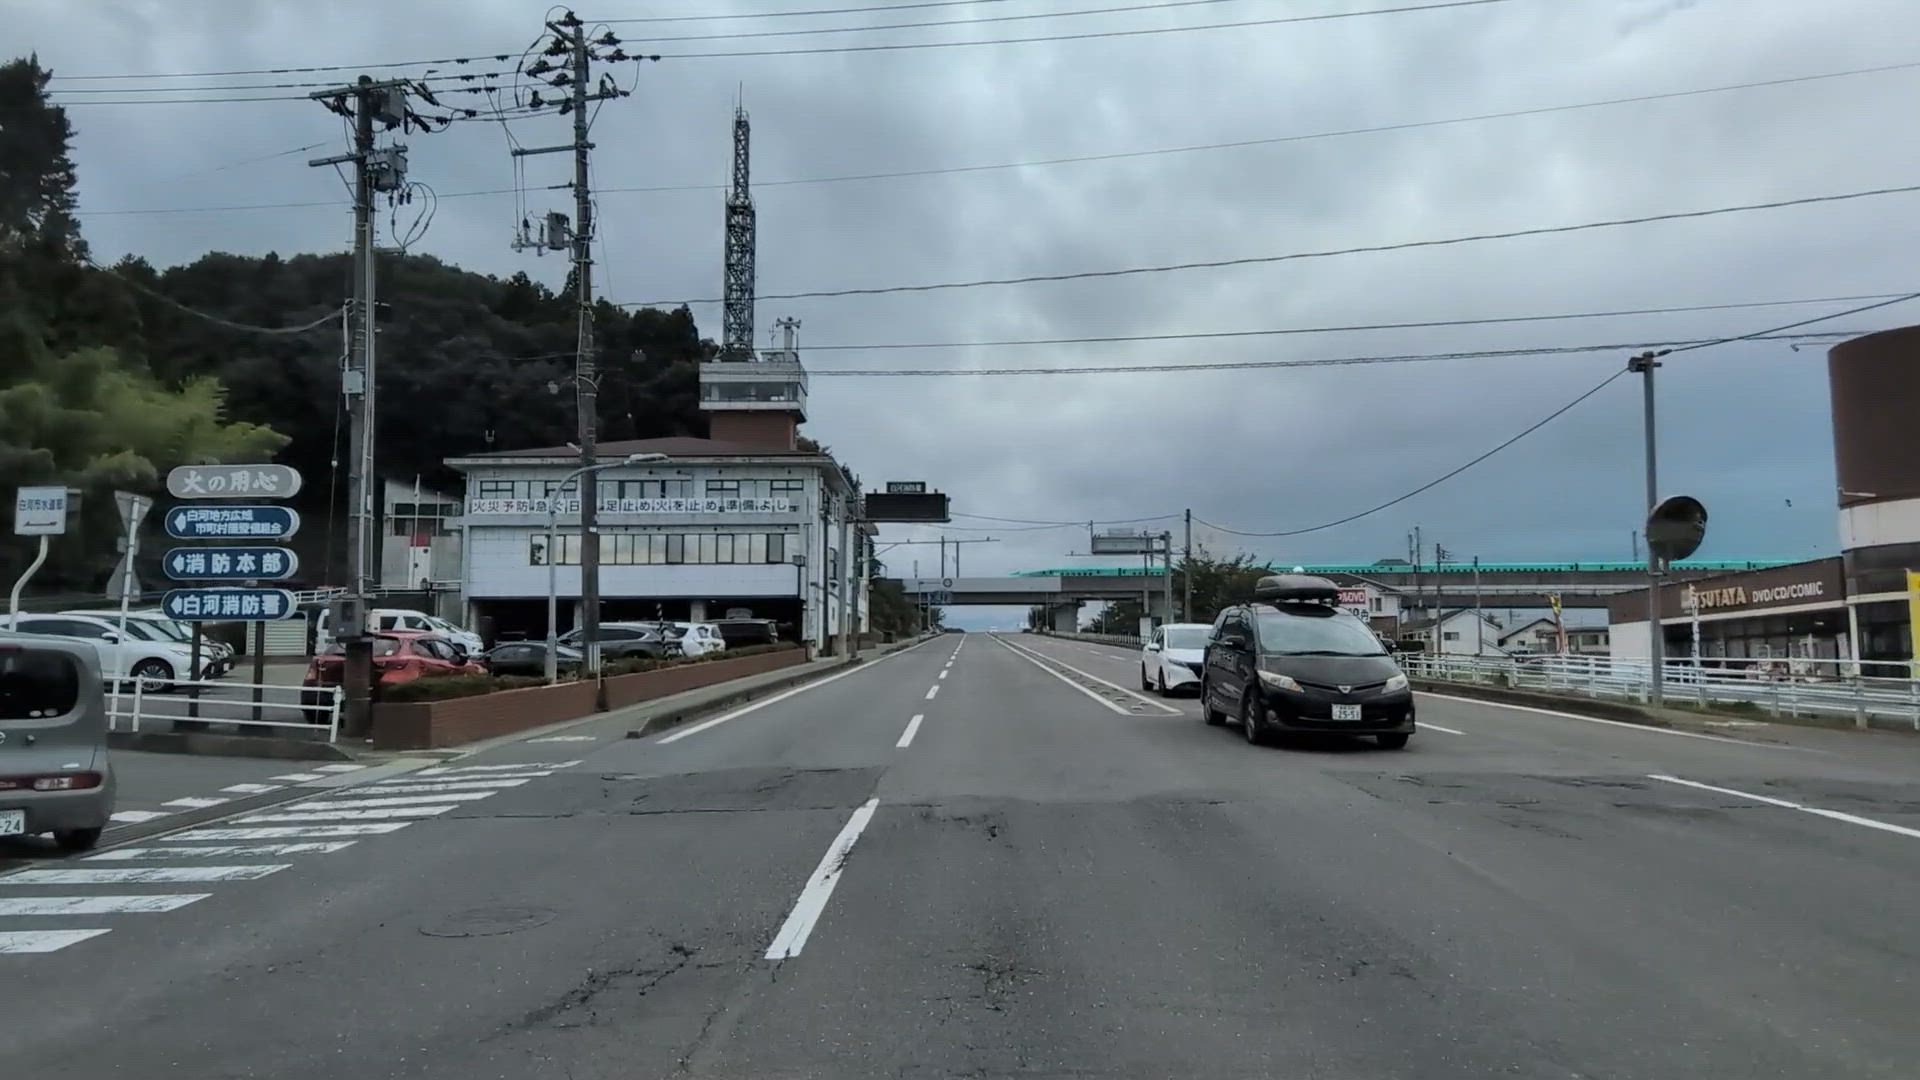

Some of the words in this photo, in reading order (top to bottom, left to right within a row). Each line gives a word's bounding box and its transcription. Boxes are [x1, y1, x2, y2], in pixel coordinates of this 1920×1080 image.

[182, 470, 279, 494] 火の用心
[187, 509, 254, 522] 白河地方広域
[185, 552, 281, 574] 消防本部
[1752, 581, 1824, 603] DVD/CD/COMIC
[183, 594, 280, 615] 白河消防署
